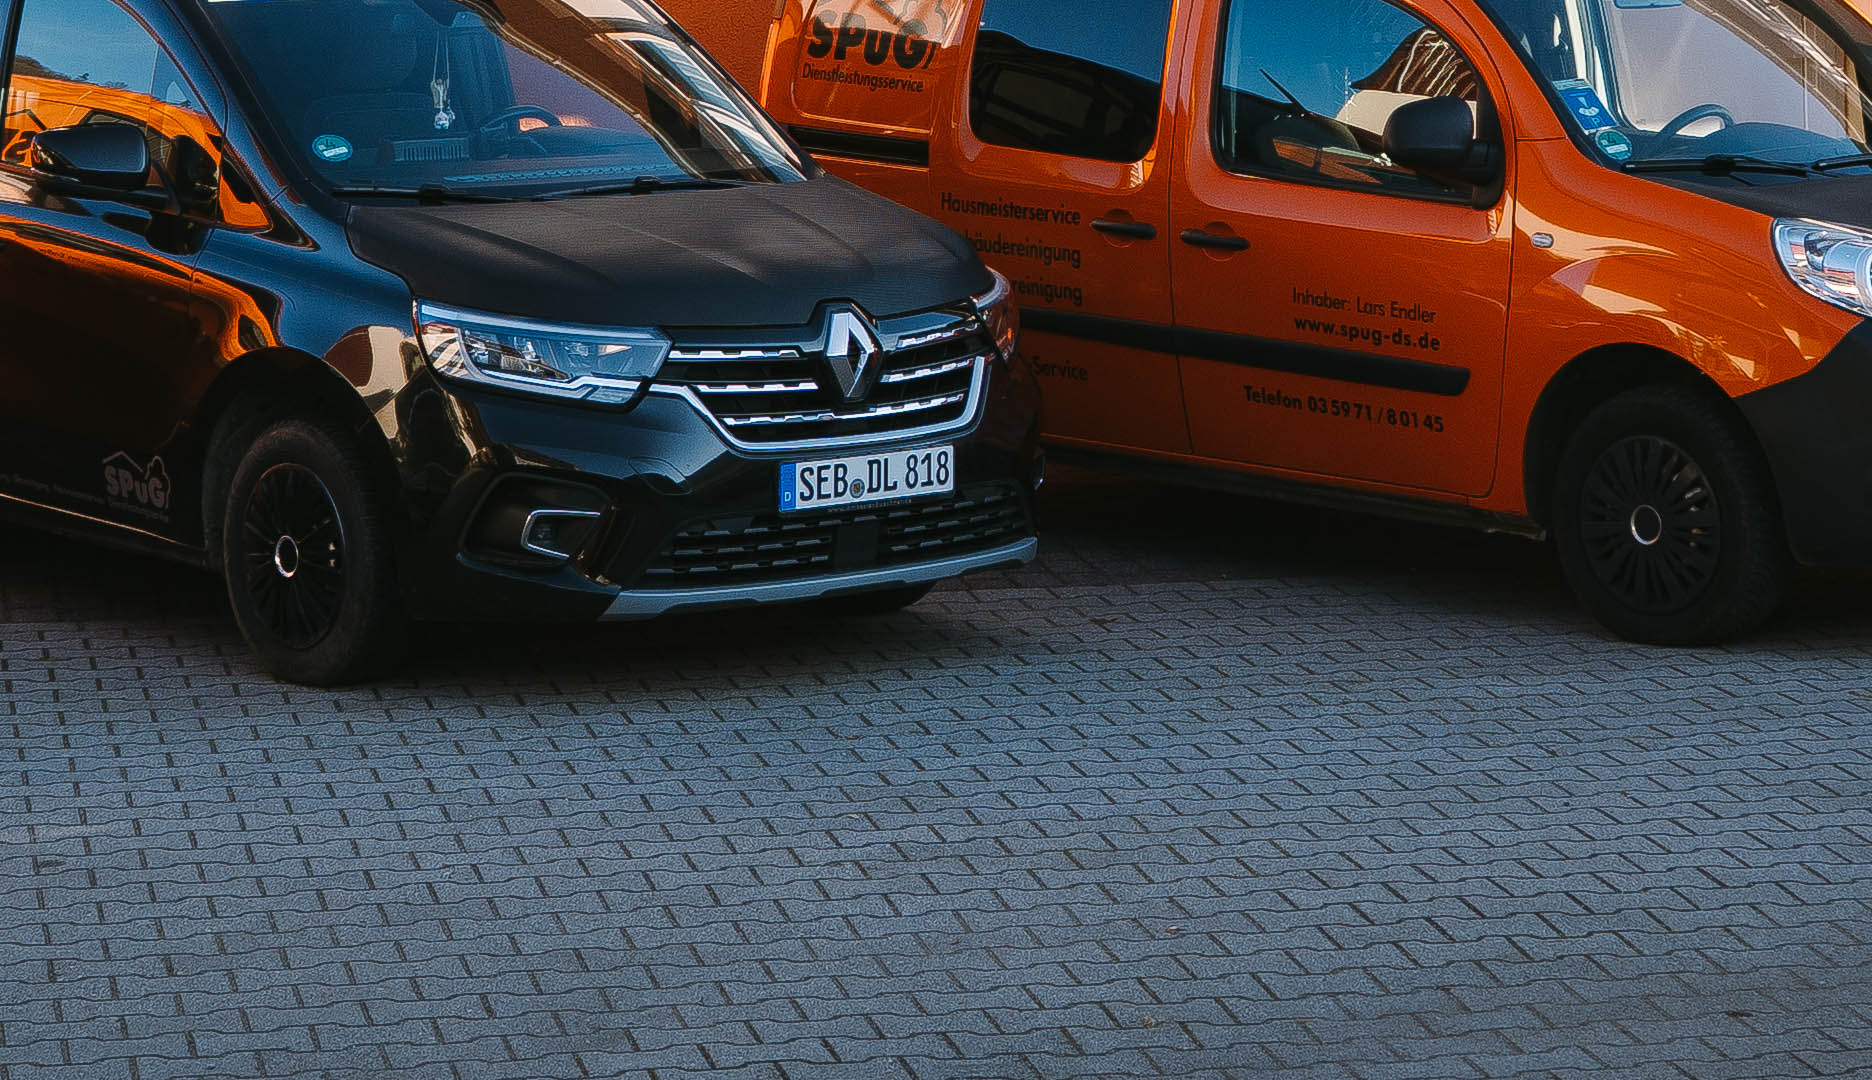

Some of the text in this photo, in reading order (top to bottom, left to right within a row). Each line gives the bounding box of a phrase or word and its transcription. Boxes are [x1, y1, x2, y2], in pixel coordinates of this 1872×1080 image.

[802, 62, 924, 93] Dienstleistungsservice
[940, 191, 1081, 225] Hausmeisterservice
[963, 228, 1081, 269] bäudereinigung
[1011, 277, 1083, 306] reinigung
[1291, 286, 1437, 324] Inhaber: Lars Endler
[1293, 317, 1441, 352] www.spug-ds.de
[1242, 384, 1303, 410] Telefon
[783, 450, 950, 502] D SEB DL 818
